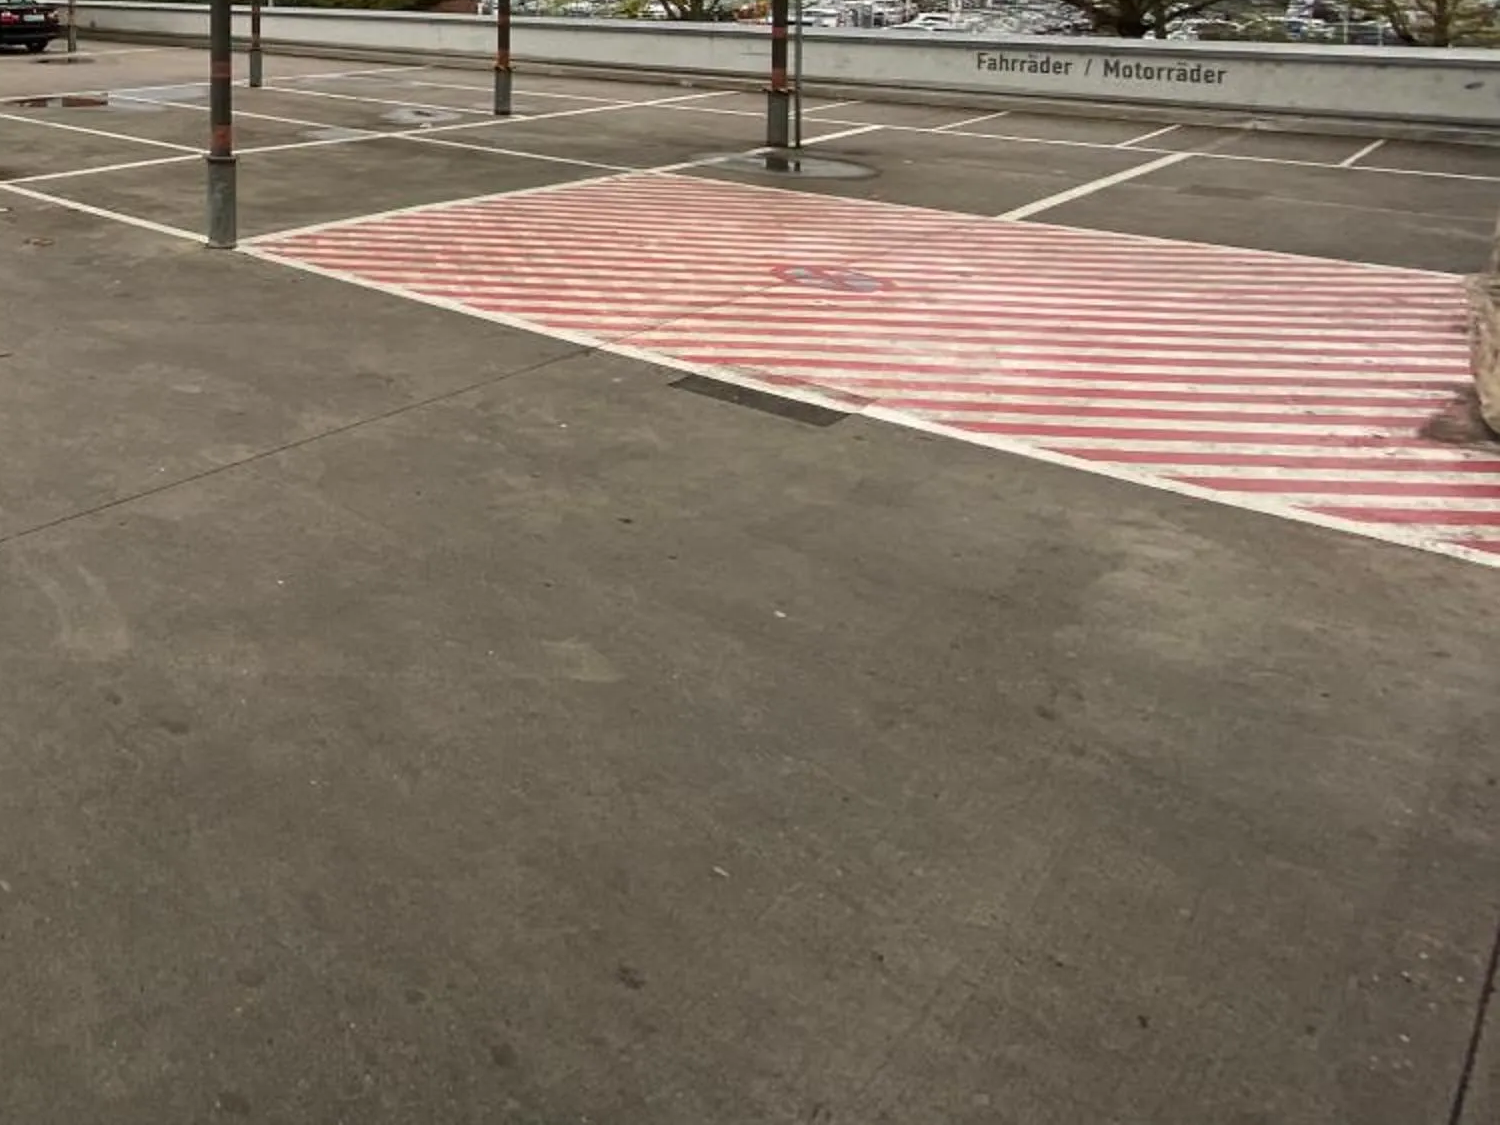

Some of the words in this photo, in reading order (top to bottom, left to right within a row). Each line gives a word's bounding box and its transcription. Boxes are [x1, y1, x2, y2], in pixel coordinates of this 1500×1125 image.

[976, 52, 1073, 75] Fahrräder
[1084, 58, 1092, 76] /
[1103, 59, 1227, 84] Motorräder
